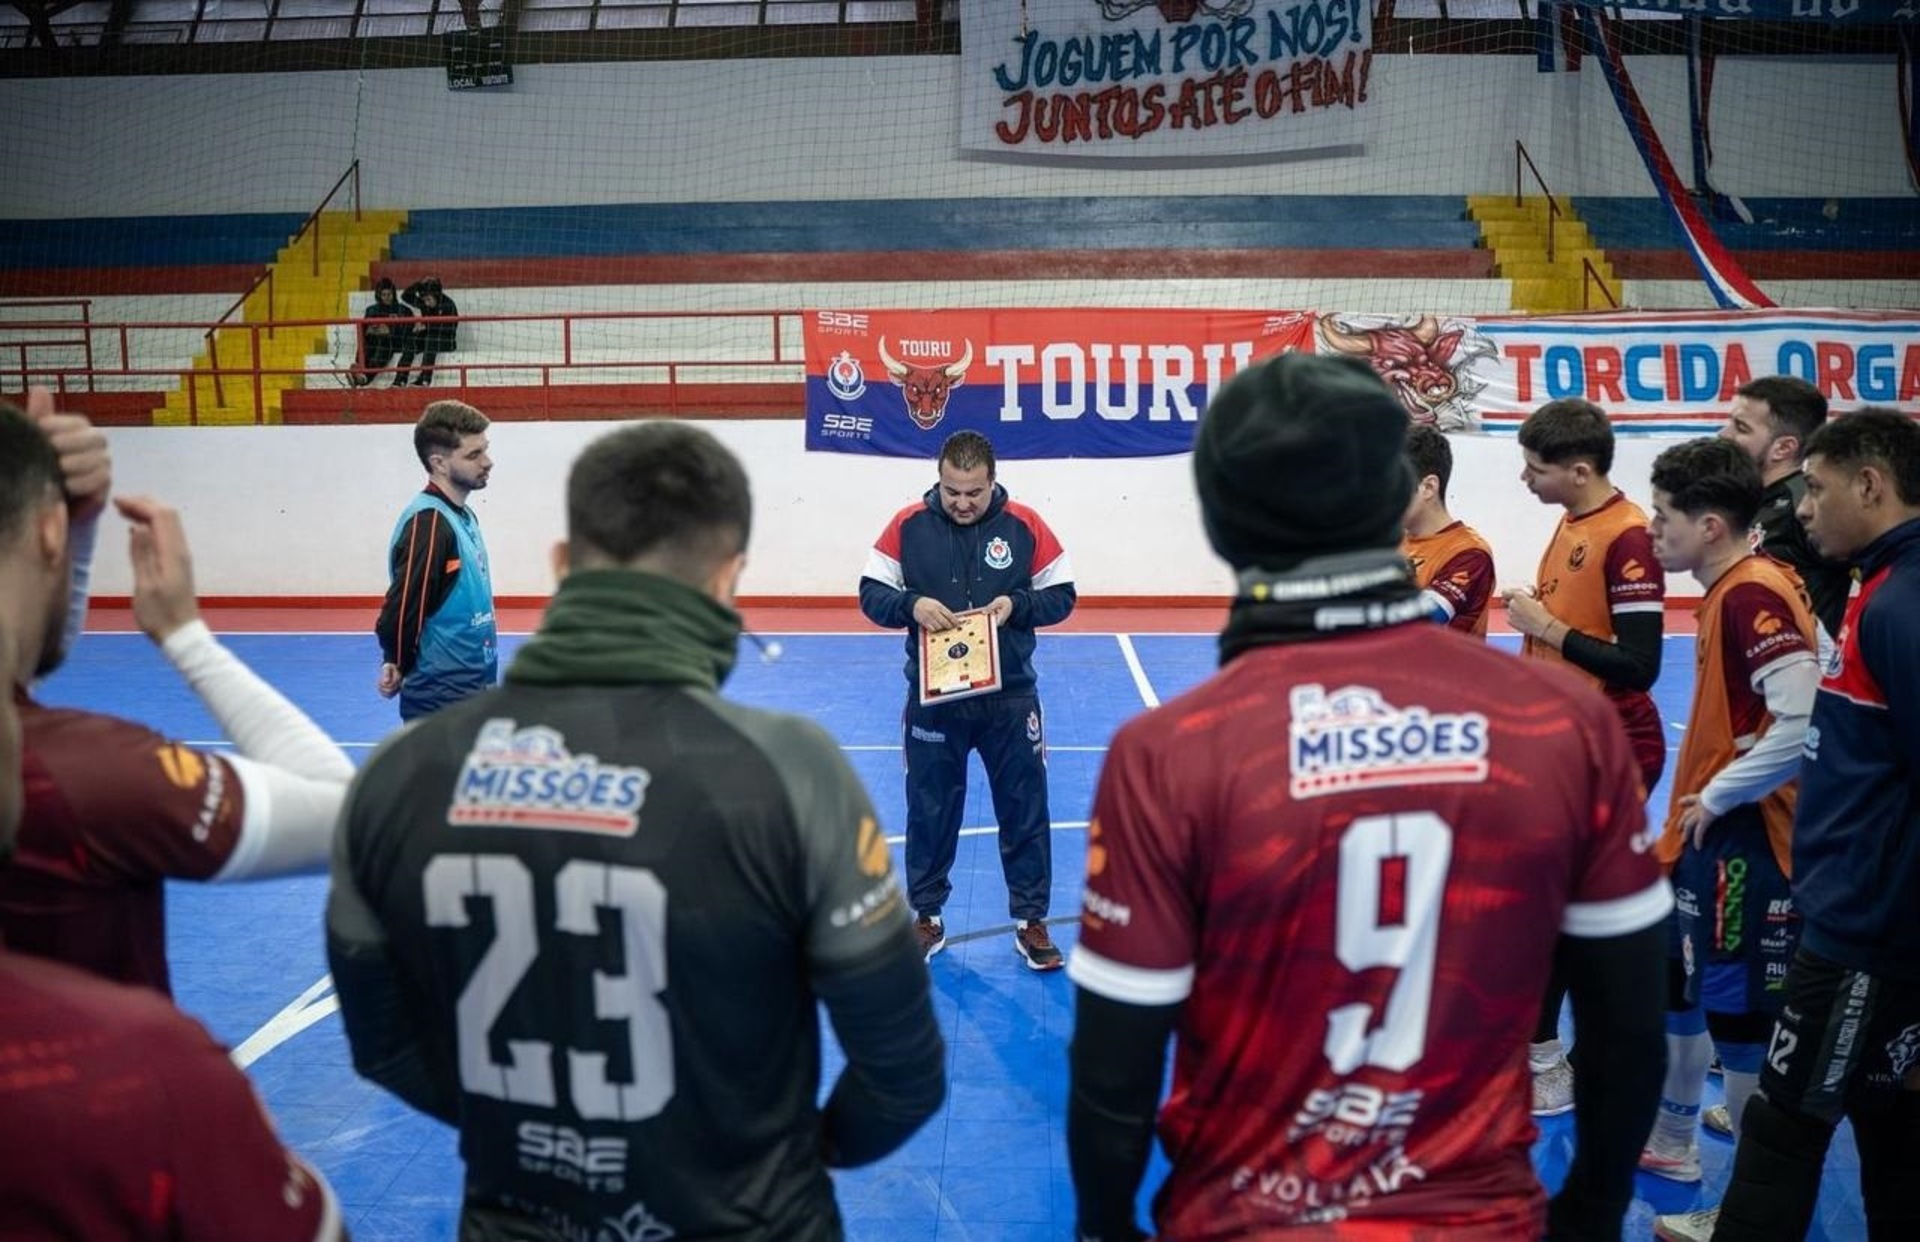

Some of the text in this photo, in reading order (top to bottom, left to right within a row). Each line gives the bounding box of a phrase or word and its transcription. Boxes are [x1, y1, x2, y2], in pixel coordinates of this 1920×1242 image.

[994, 28, 1163, 91] JOGUEM
[1169, 16, 1260, 73] POR
[995, 49, 1373, 144] JUNTOS ATÉ O FIM!
[817, 326, 869, 337] SPORTS
[818, 311, 869, 329] SBE
[899, 339, 952, 358] TOURU
[1504, 341, 1752, 402] TORCIDA
[820, 428, 871, 441] SPORTS
[823, 413, 873, 433] SBE
[1297, 714, 1481, 767] MISSÕES
[462, 760, 642, 808] MISSÕES
[1323, 810, 1453, 1075] 9
[423, 853, 676, 1122] 23
[1767, 1019, 1798, 1077] 12
[1295, 1083, 1425, 1127] SBE
[517, 1120, 628, 1173] SBE
